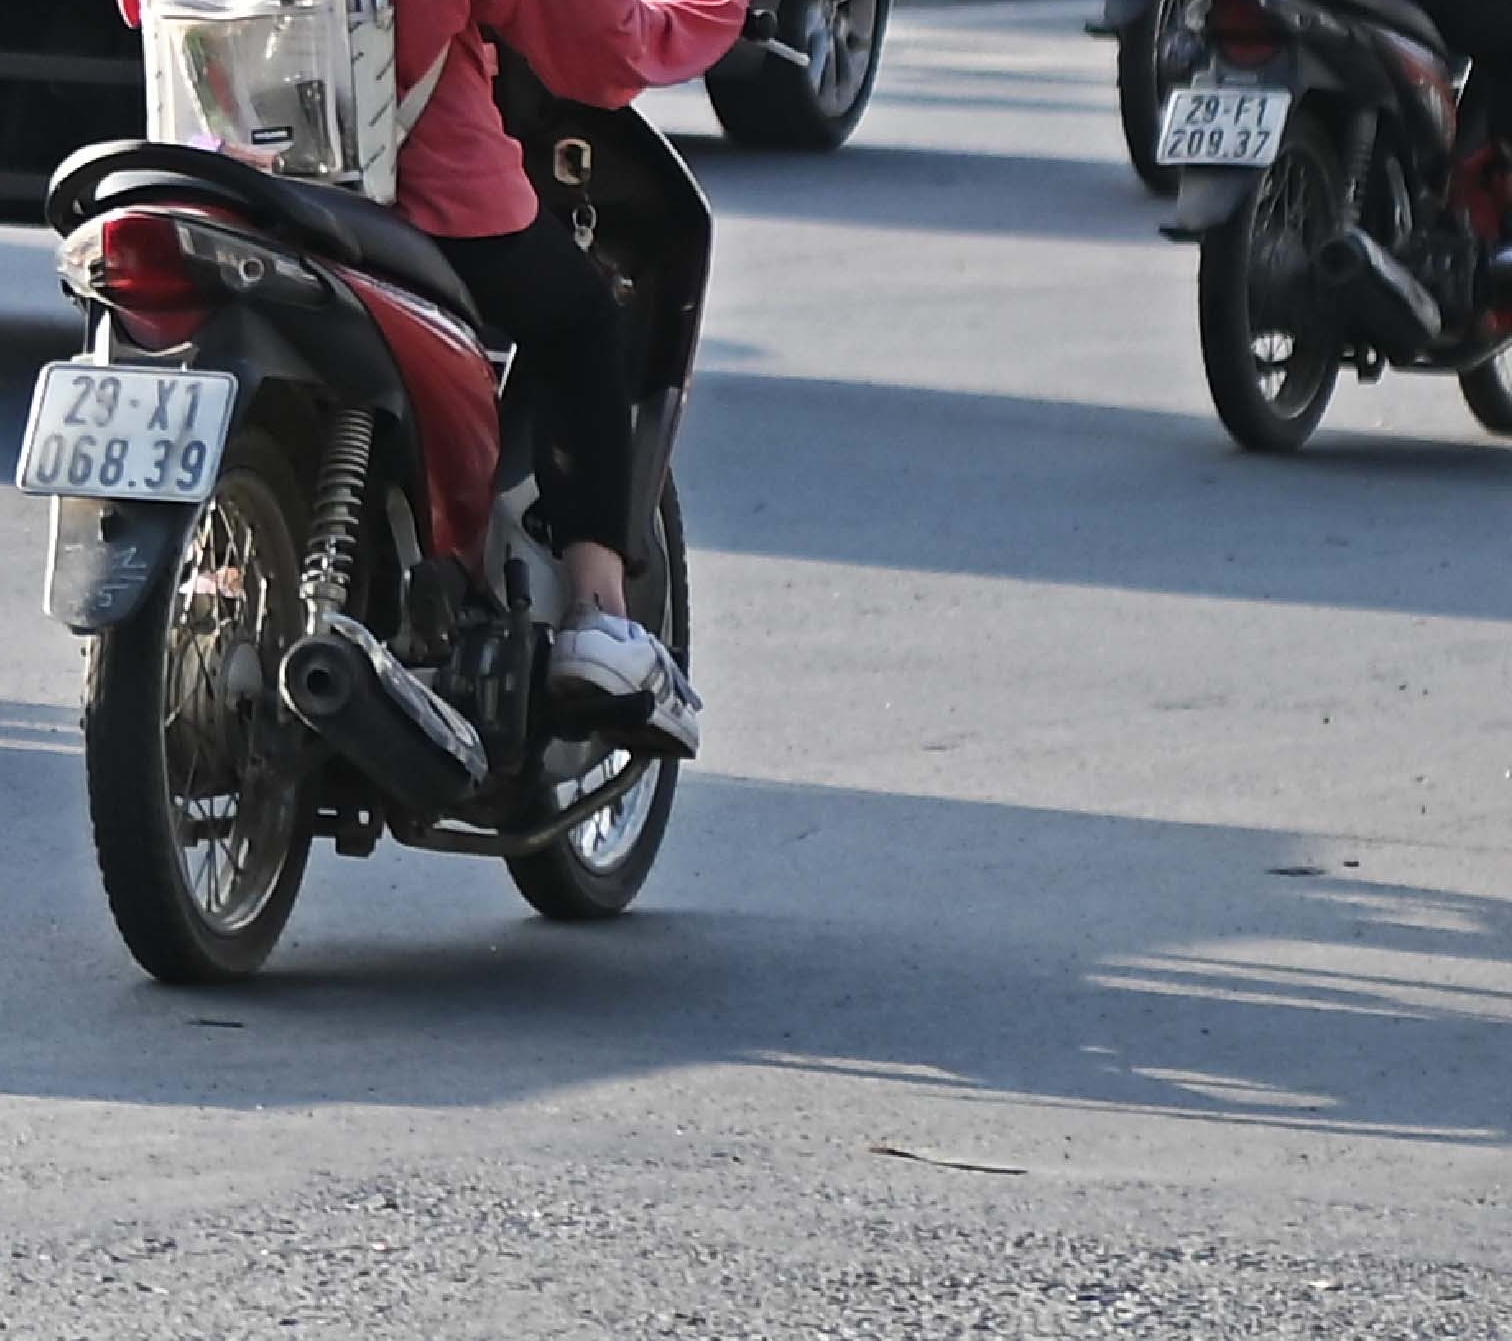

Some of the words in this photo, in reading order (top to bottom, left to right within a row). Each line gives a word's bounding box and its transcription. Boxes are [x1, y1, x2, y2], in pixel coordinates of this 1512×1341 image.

[1185, 94, 1268, 127] 29-F1
[62, 374, 203, 432] 29-X1
[34, 433, 208, 493] 068.39
